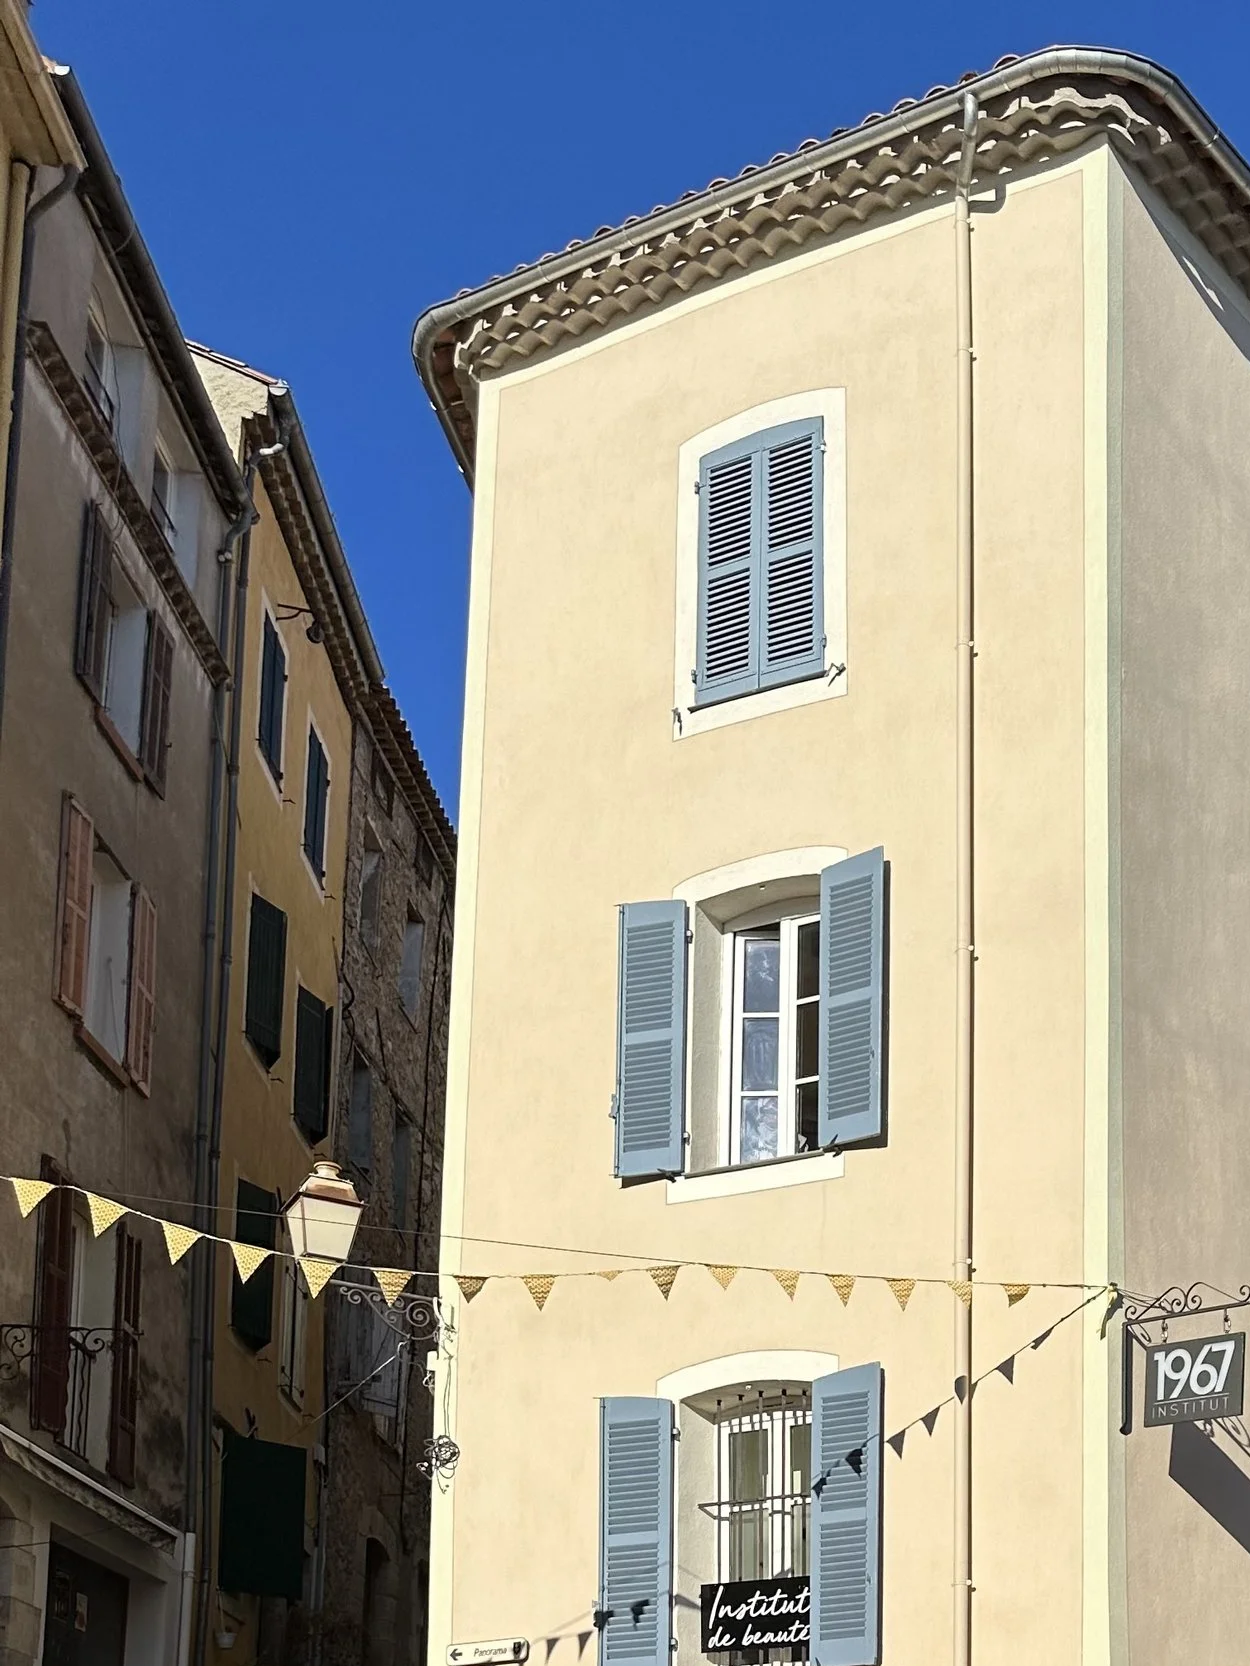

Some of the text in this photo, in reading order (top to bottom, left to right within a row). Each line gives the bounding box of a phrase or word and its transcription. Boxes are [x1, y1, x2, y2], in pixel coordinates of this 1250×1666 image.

[1153, 1340, 1235, 1401] 1967
[1152, 1396, 1229, 1419] INSTITUT
[708, 1585, 811, 1629] Institut
[707, 1626, 736, 1649] de
[473, 1647, 508, 1658] Panorama
